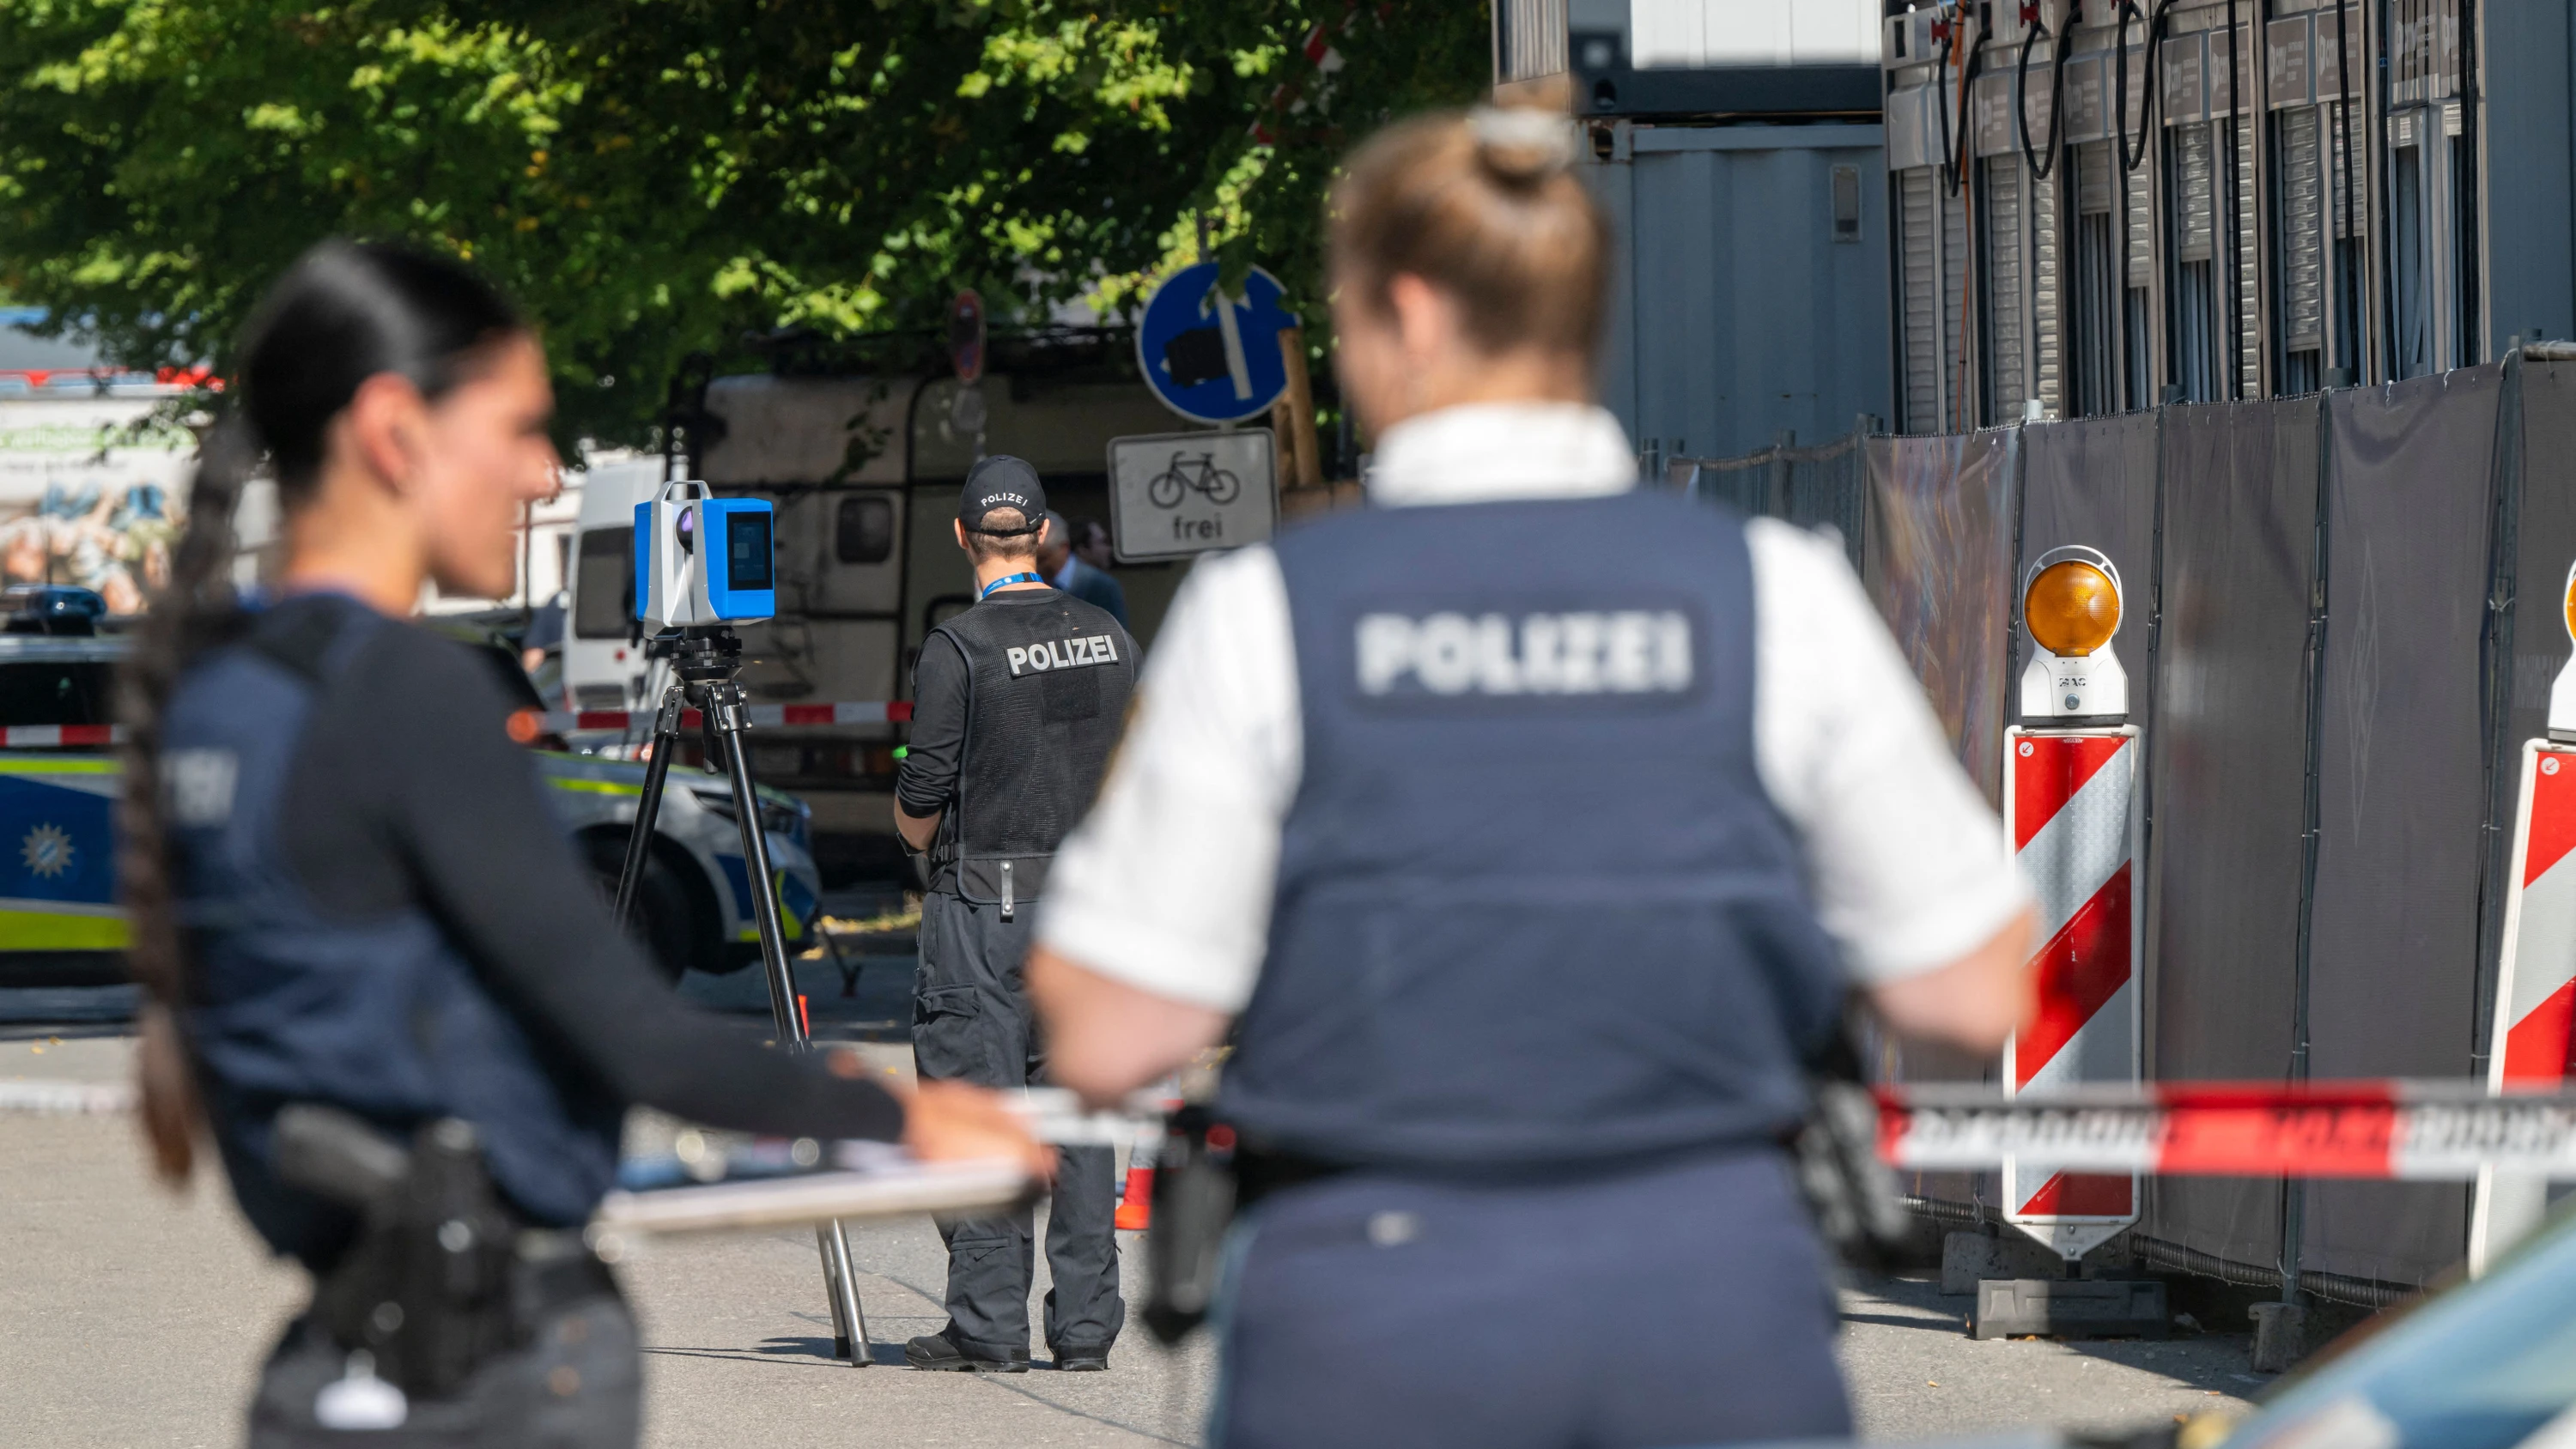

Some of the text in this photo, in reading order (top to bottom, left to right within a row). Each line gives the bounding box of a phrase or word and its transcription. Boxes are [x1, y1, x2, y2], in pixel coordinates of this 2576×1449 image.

[981, 492, 1028, 507] POLIZEI
[1173, 513, 1223, 539] frei
[1006, 634, 1118, 675] POLIZEI
[1357, 611, 1692, 694] POLIZEI
